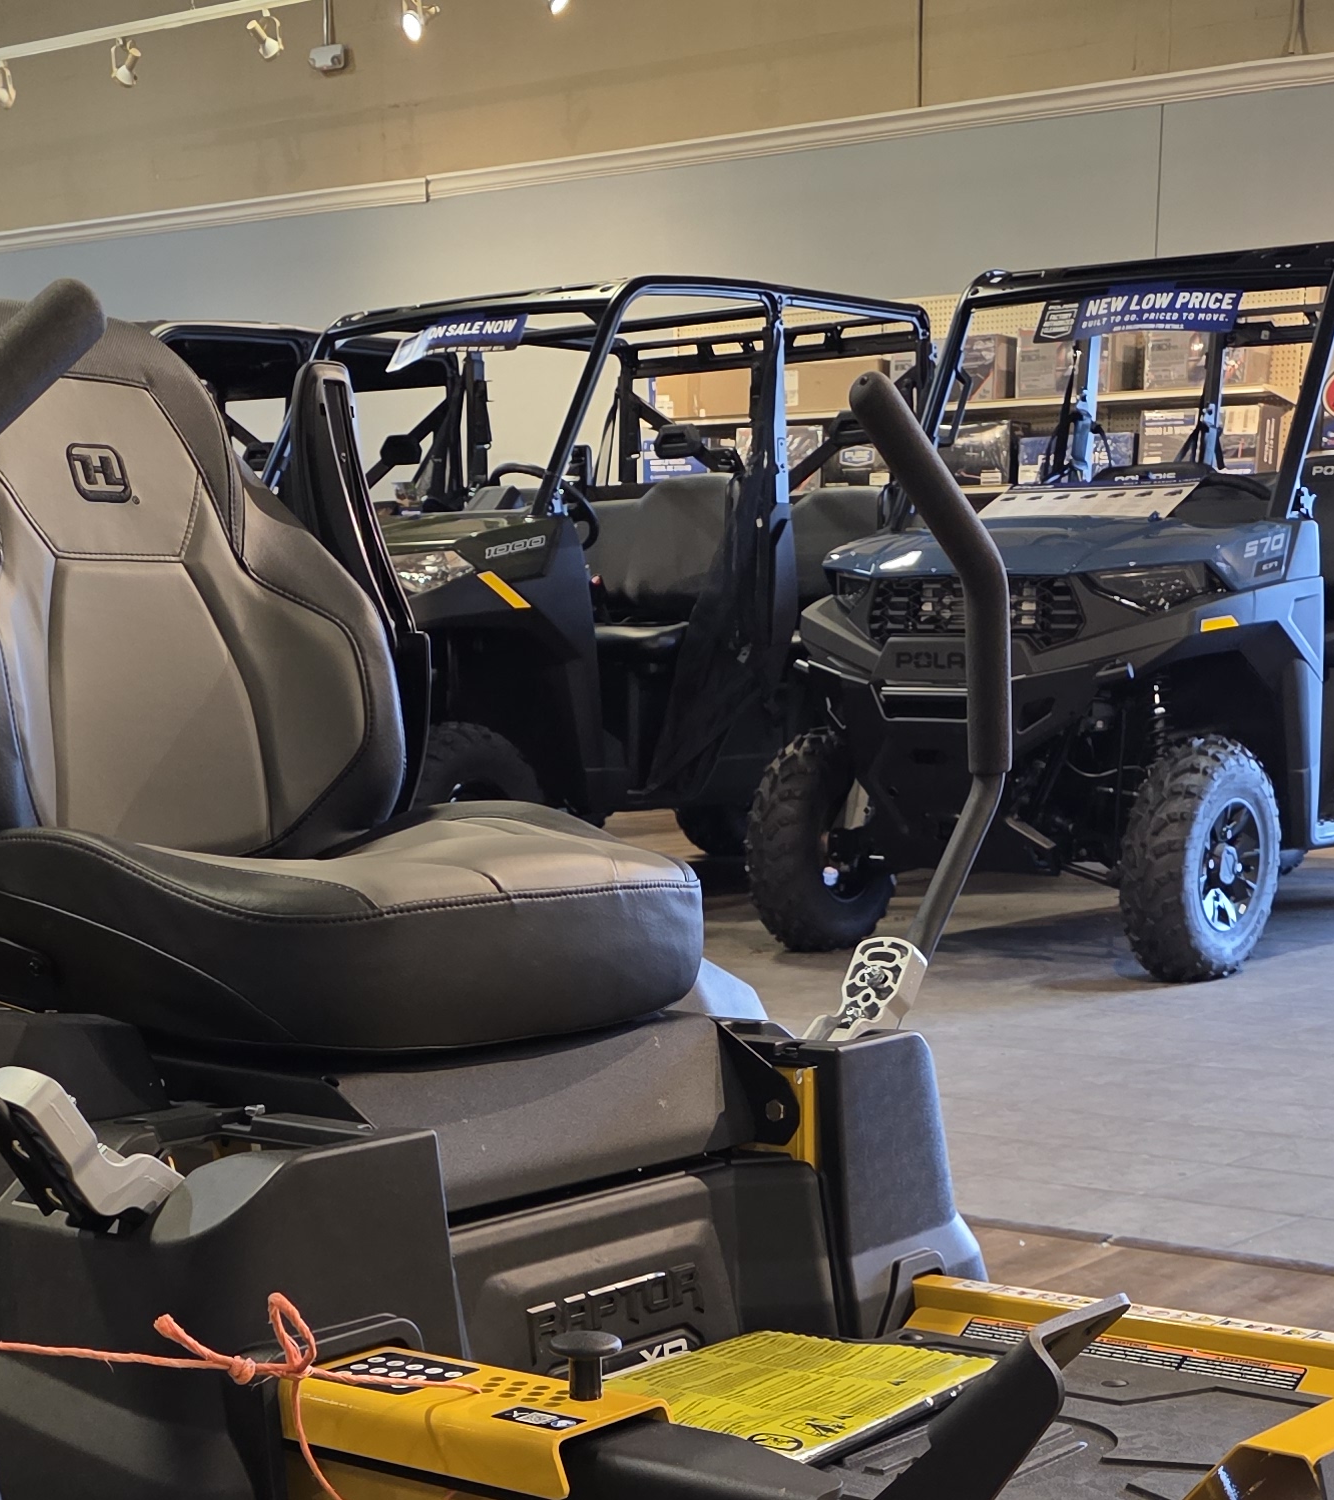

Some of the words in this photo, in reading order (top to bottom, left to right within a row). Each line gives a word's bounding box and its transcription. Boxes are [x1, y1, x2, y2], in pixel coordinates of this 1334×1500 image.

[1085, 296, 1128, 317] NEW
[1129, 292, 1174, 311] LOW
[1175, 291, 1237, 310] PRICE
[428, 326, 447, 340] ON
[445, 321, 484, 336] SALE
[482, 318, 517, 334] NOW
[1081, 317, 1108, 330] BUILT
[1110, 315, 1121, 324] TO
[1142, 312, 1178, 321] PRICED
[1182, 312, 1195, 321] TO
[485, 535, 546, 559] 1000
[1243, 533, 1285, 558] 570
[896, 651, 966, 669] POLA
[526, 1262, 705, 1367] RAPTOR
